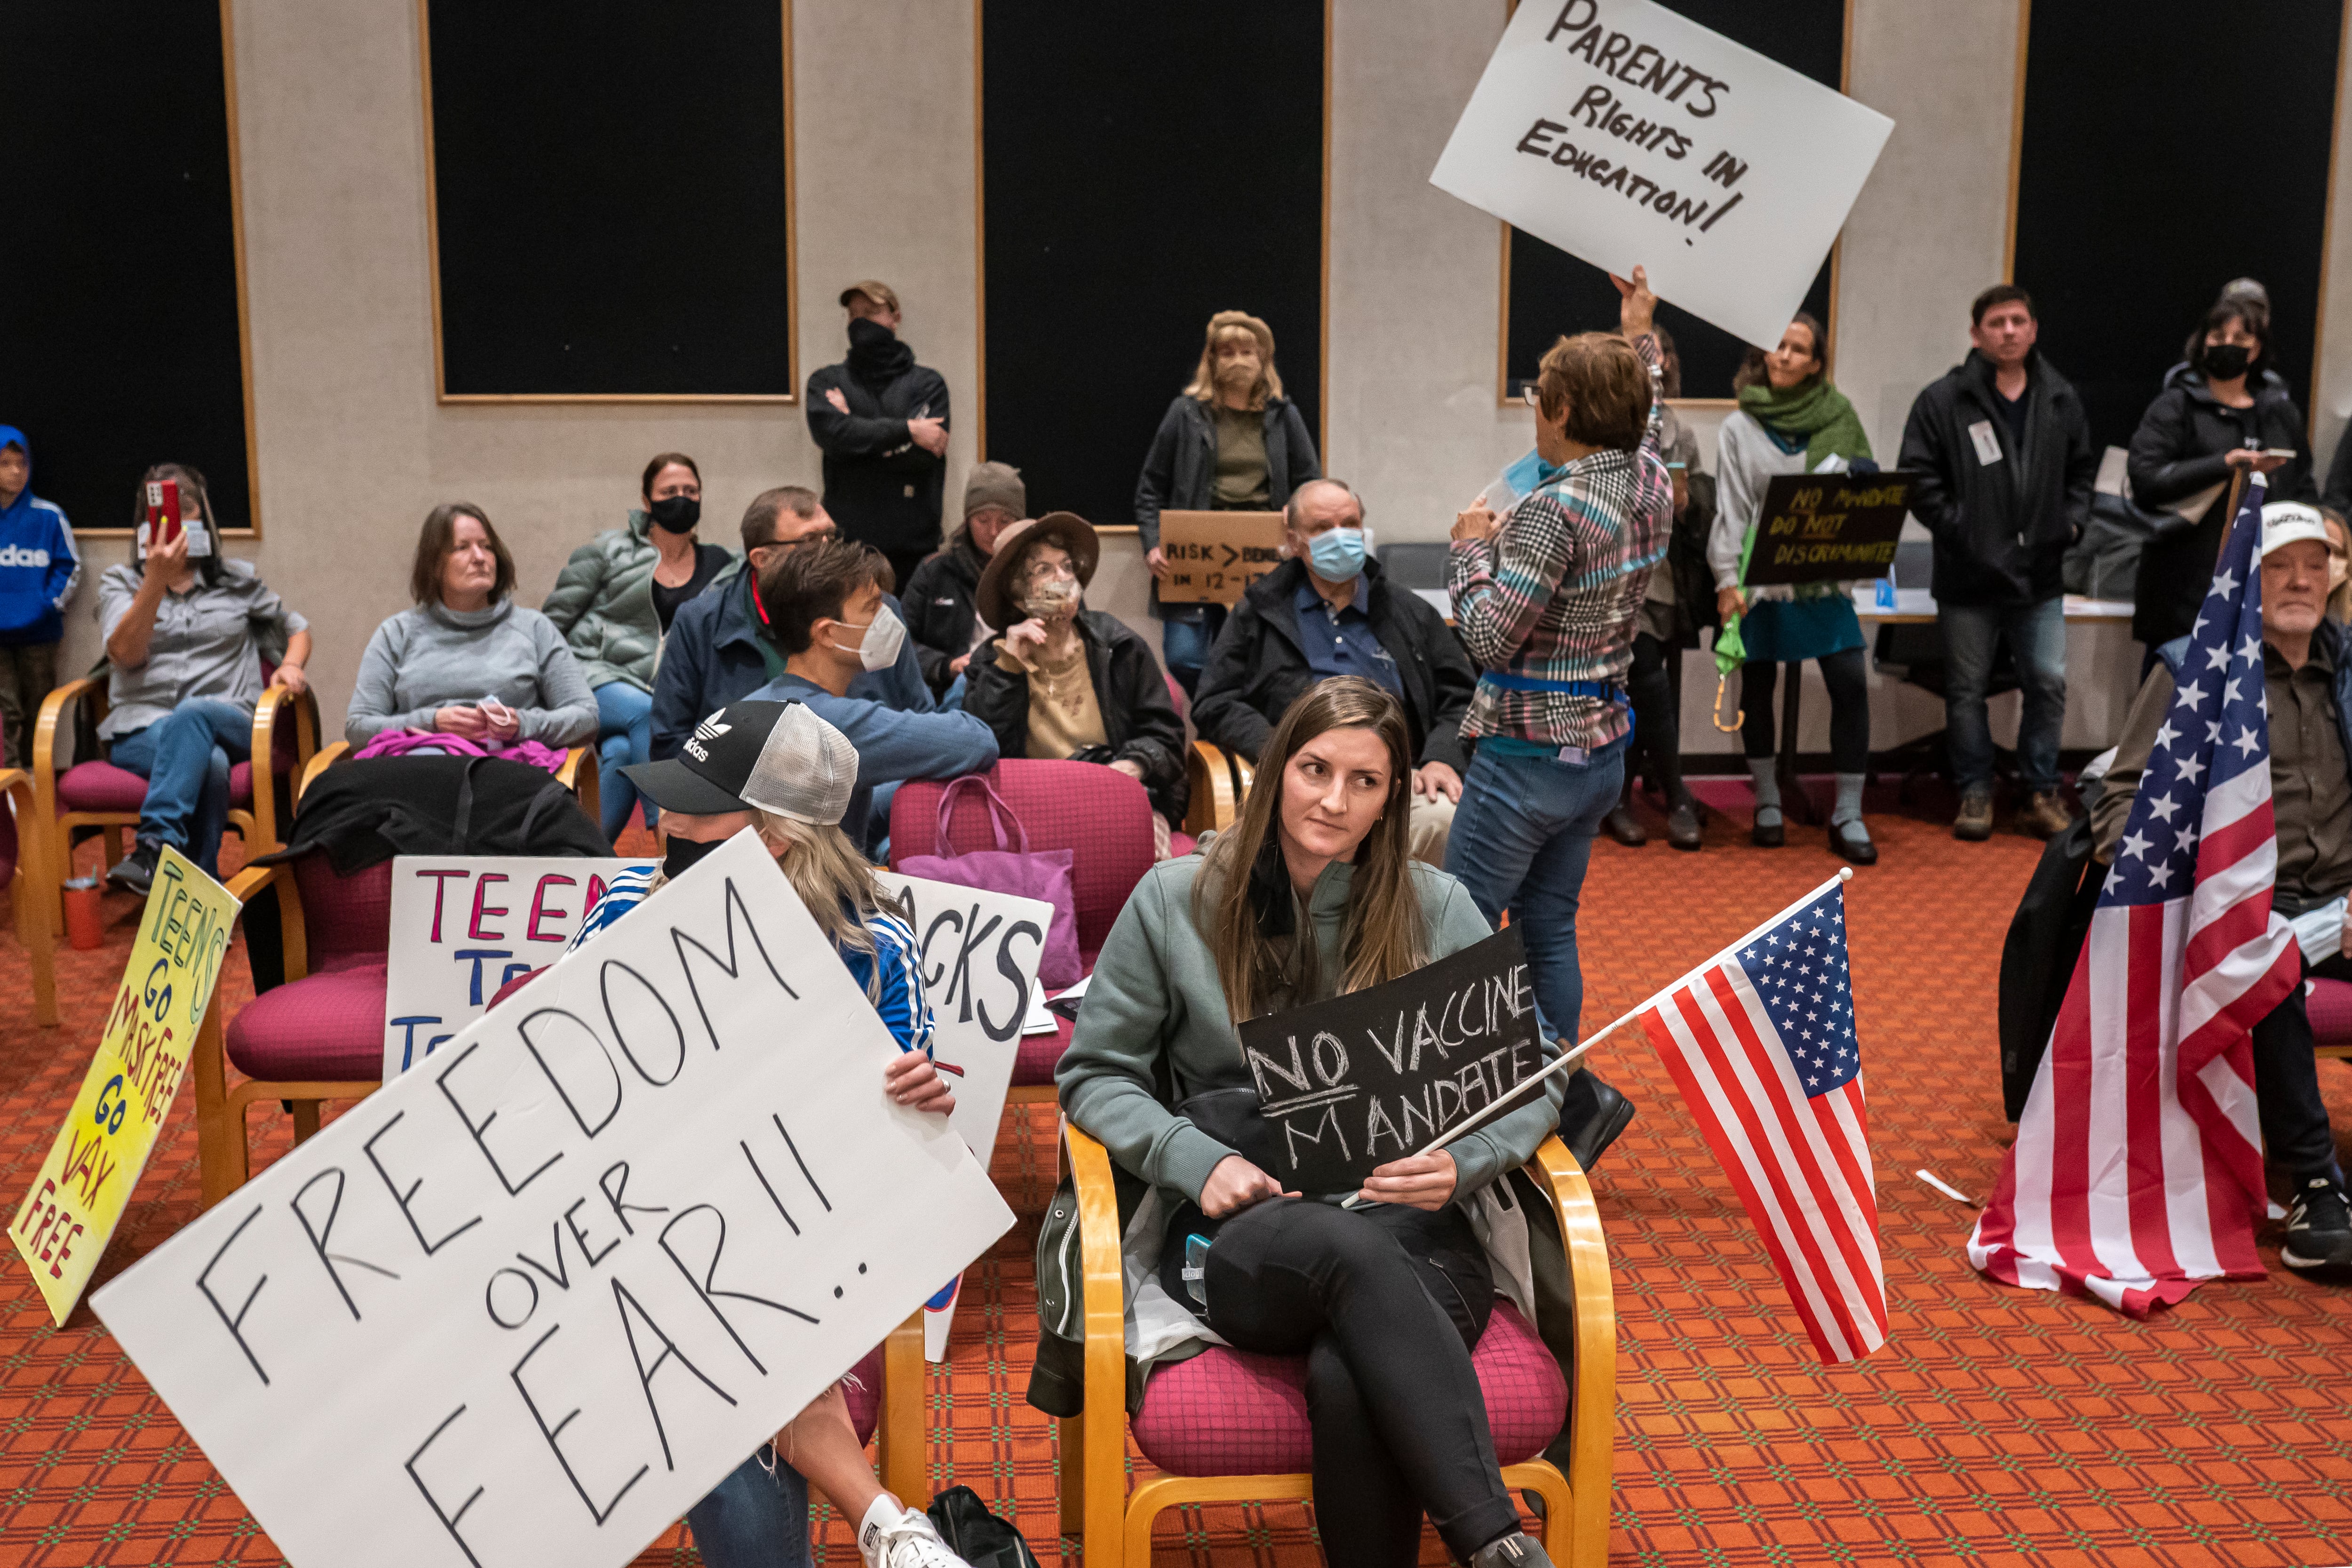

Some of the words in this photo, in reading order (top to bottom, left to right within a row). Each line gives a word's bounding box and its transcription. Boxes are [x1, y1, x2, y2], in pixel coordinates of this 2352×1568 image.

[1545, 0, 1730, 119] PARENTS
[1516, 118, 1744, 246] EDUCATION!
[1569, 85, 1693, 160] RIGHTS
[1702, 151, 1748, 189] IN
[1167, 542, 1214, 561] RISK
[1790, 487, 1823, 509] NO
[1804, 513, 1849, 534] NOT
[144, 958, 172, 1022] GO
[151, 860, 224, 1024] TEENS
[107, 984, 157, 1087] MASK
[140, 1027, 182, 1124] FREE
[1247, 1030, 1350, 1102] NO
[1367, 963, 1535, 1075] VACCINE
[95, 1074, 126, 1135] GO
[195, 876, 800, 1386] FREEDOM
[1285, 1038, 1534, 1170] MANDATE
[61, 1129, 115, 1211] VAX
[20, 1178, 84, 1279] FREE
[485, 1161, 669, 1330] OVER
